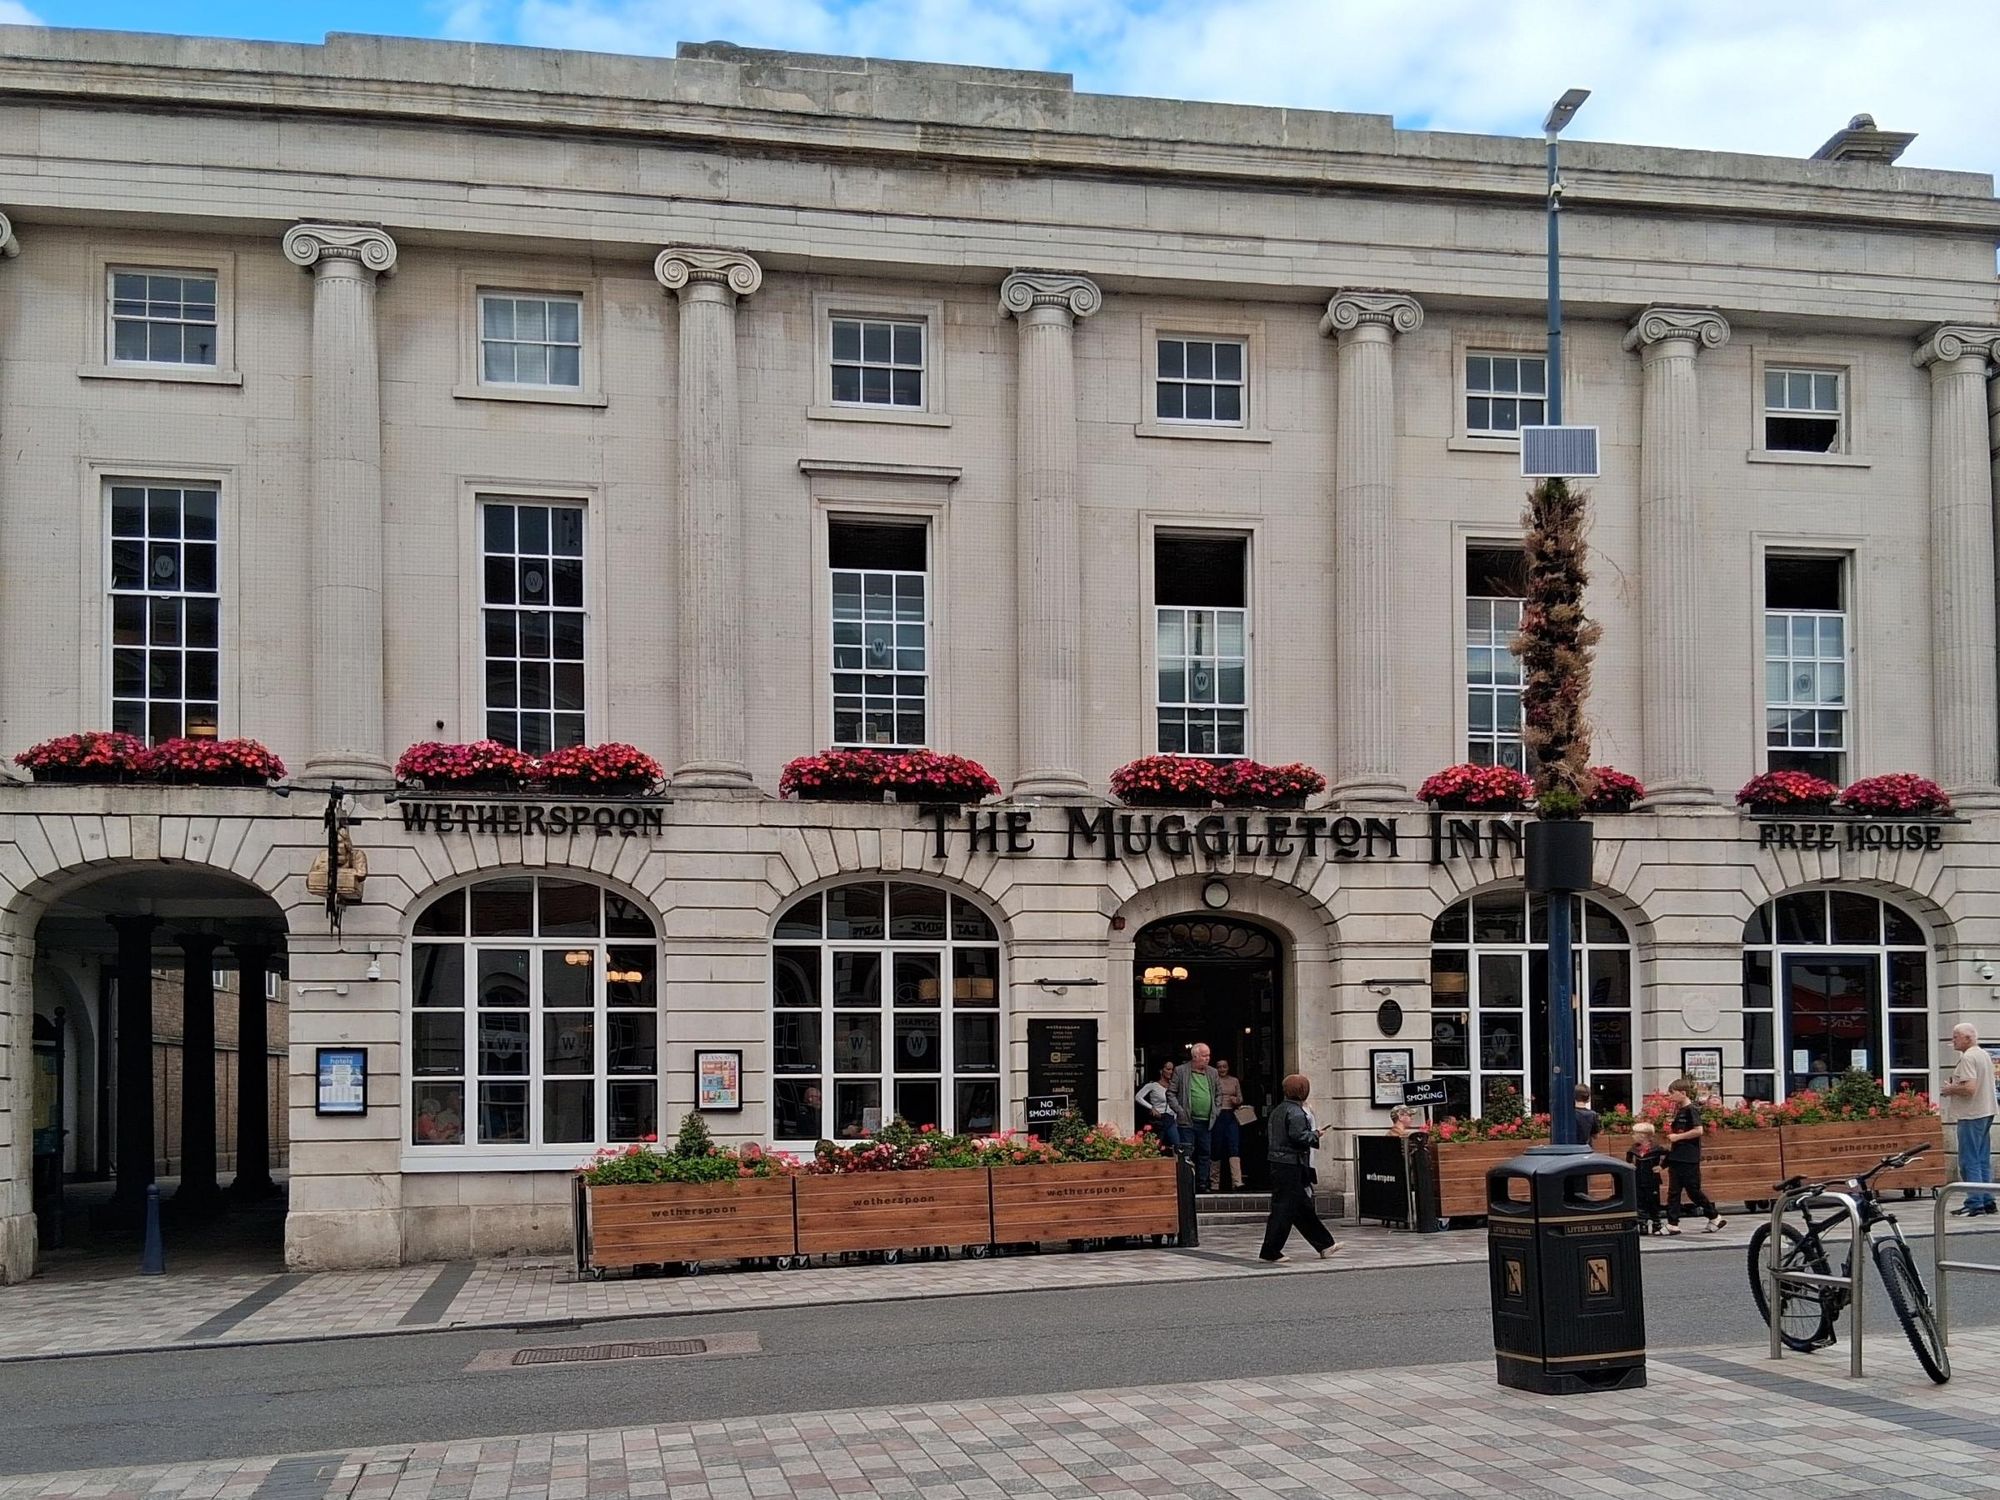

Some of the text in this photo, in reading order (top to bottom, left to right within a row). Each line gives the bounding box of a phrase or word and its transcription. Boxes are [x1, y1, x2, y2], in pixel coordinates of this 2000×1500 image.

[400, 802, 664, 838] WETHERSPOON
[919, 803, 1525, 864] THE MUGGLETON INN
[1758, 823, 1943, 852] FREE HOUSE
[562, 1037, 576, 1050] W
[850, 1036, 864, 1050] W
[911, 1036, 924, 1049] W
[1417, 1084, 1430, 1093] NO
[1406, 1091, 1443, 1102] SMOKING
[1830, 1142, 1898, 1152] wetherspoon
[1047, 1186, 1125, 1196] wetherspoon
[853, 1195, 935, 1206] wetherspoon
[651, 1206, 737, 1217] wetherspoon
